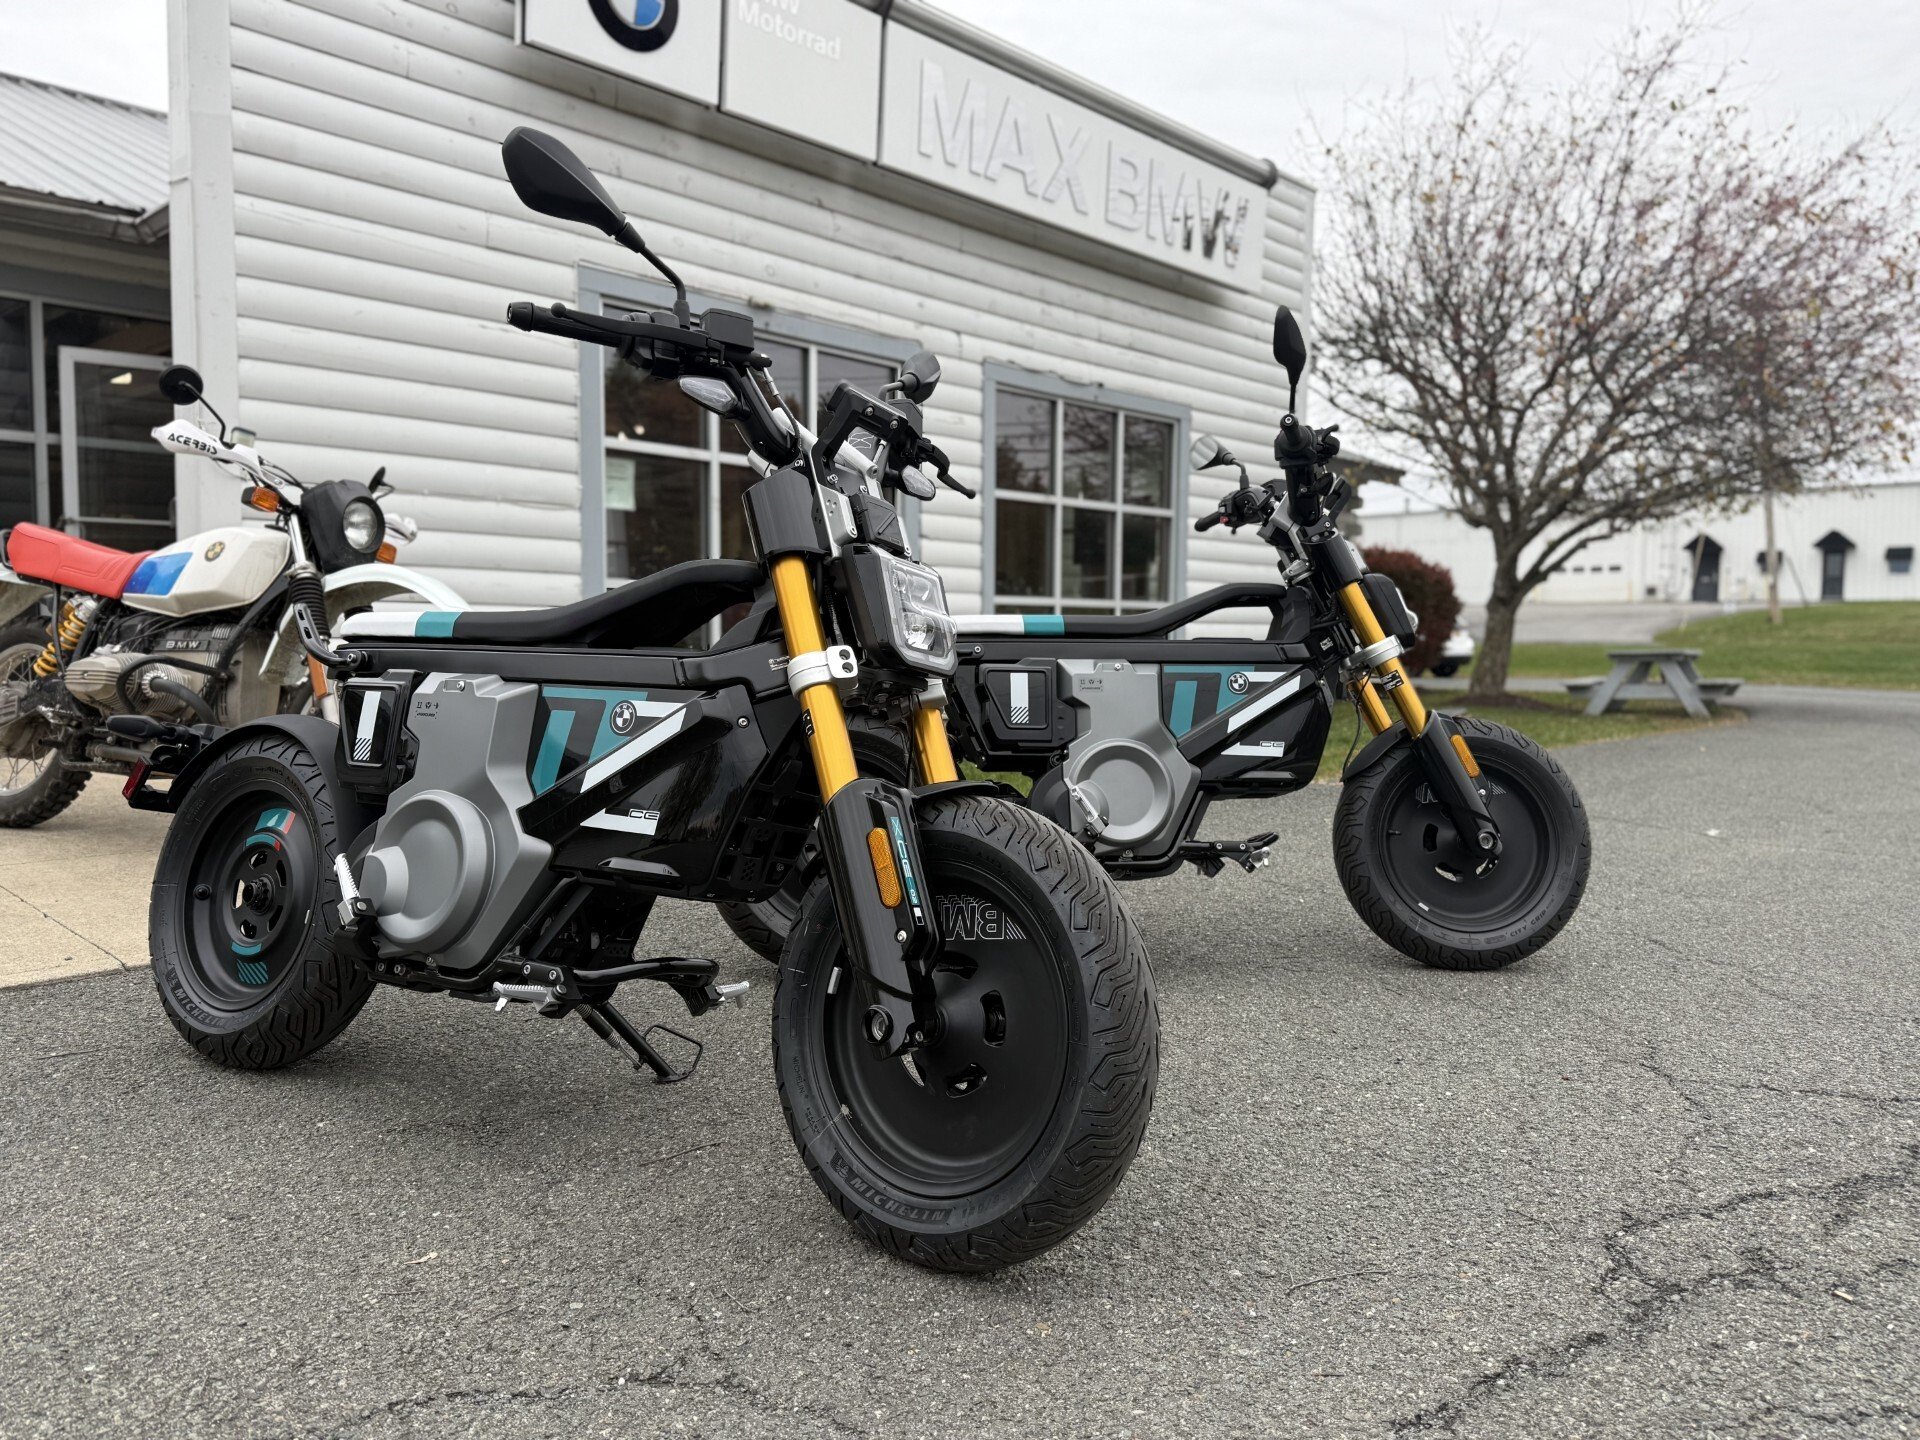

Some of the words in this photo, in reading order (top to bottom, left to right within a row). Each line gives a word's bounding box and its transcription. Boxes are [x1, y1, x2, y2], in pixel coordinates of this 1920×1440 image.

[738, 0, 841, 60] Motorrad
[918, 57, 1090, 216] MAX
[1104, 140, 1249, 268] BMW
[165, 641, 199, 649] BMW
[629, 809, 660, 821] CE
[943, 903, 1005, 941] BM
[1510, 925, 1527, 937] CITY
[1530, 909, 1547, 926] GRIP
[175, 987, 226, 1028] MICHELIN
[850, 1178, 946, 1222] MICHELIN
